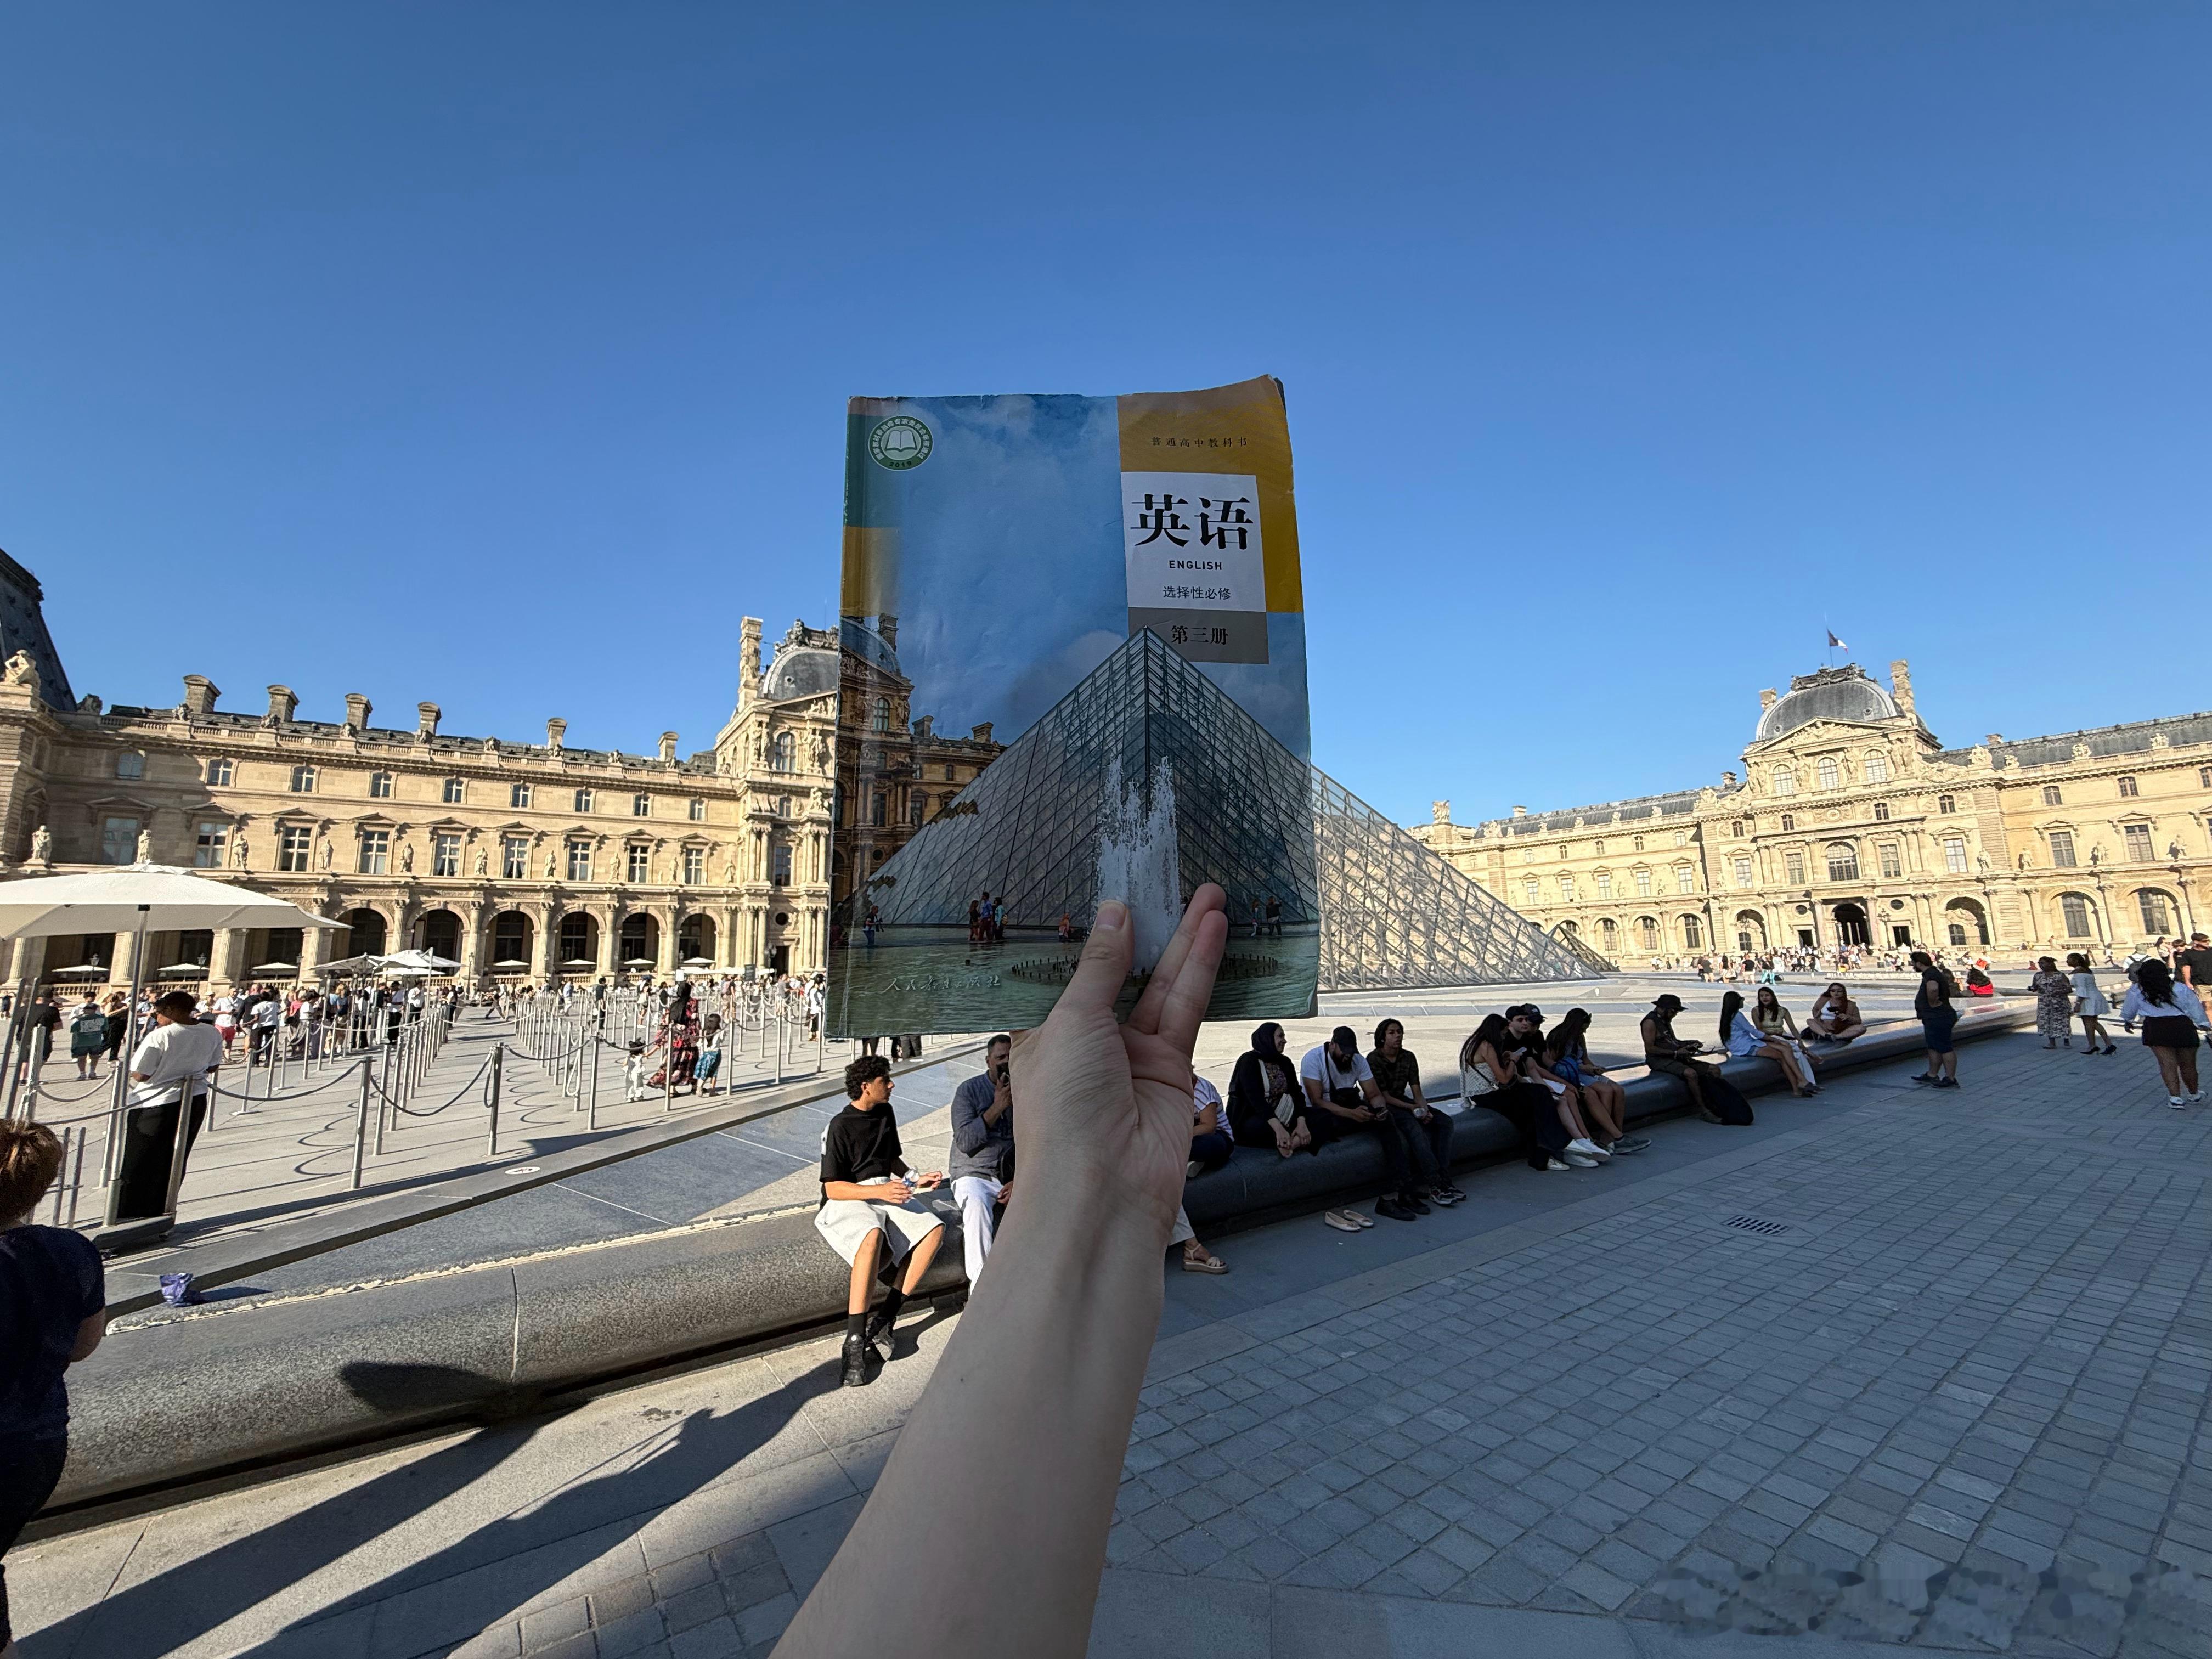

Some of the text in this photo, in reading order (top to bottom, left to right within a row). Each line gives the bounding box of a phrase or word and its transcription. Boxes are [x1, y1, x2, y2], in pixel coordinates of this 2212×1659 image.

[1152, 436, 1247, 448] 普通高中教科书
[1131, 494, 1253, 550] 英语
[1169, 560, 1222, 570] ENGLISH
[1163, 585, 1231, 600] 选择性必修
[1171, 625, 1229, 645] 第三册
